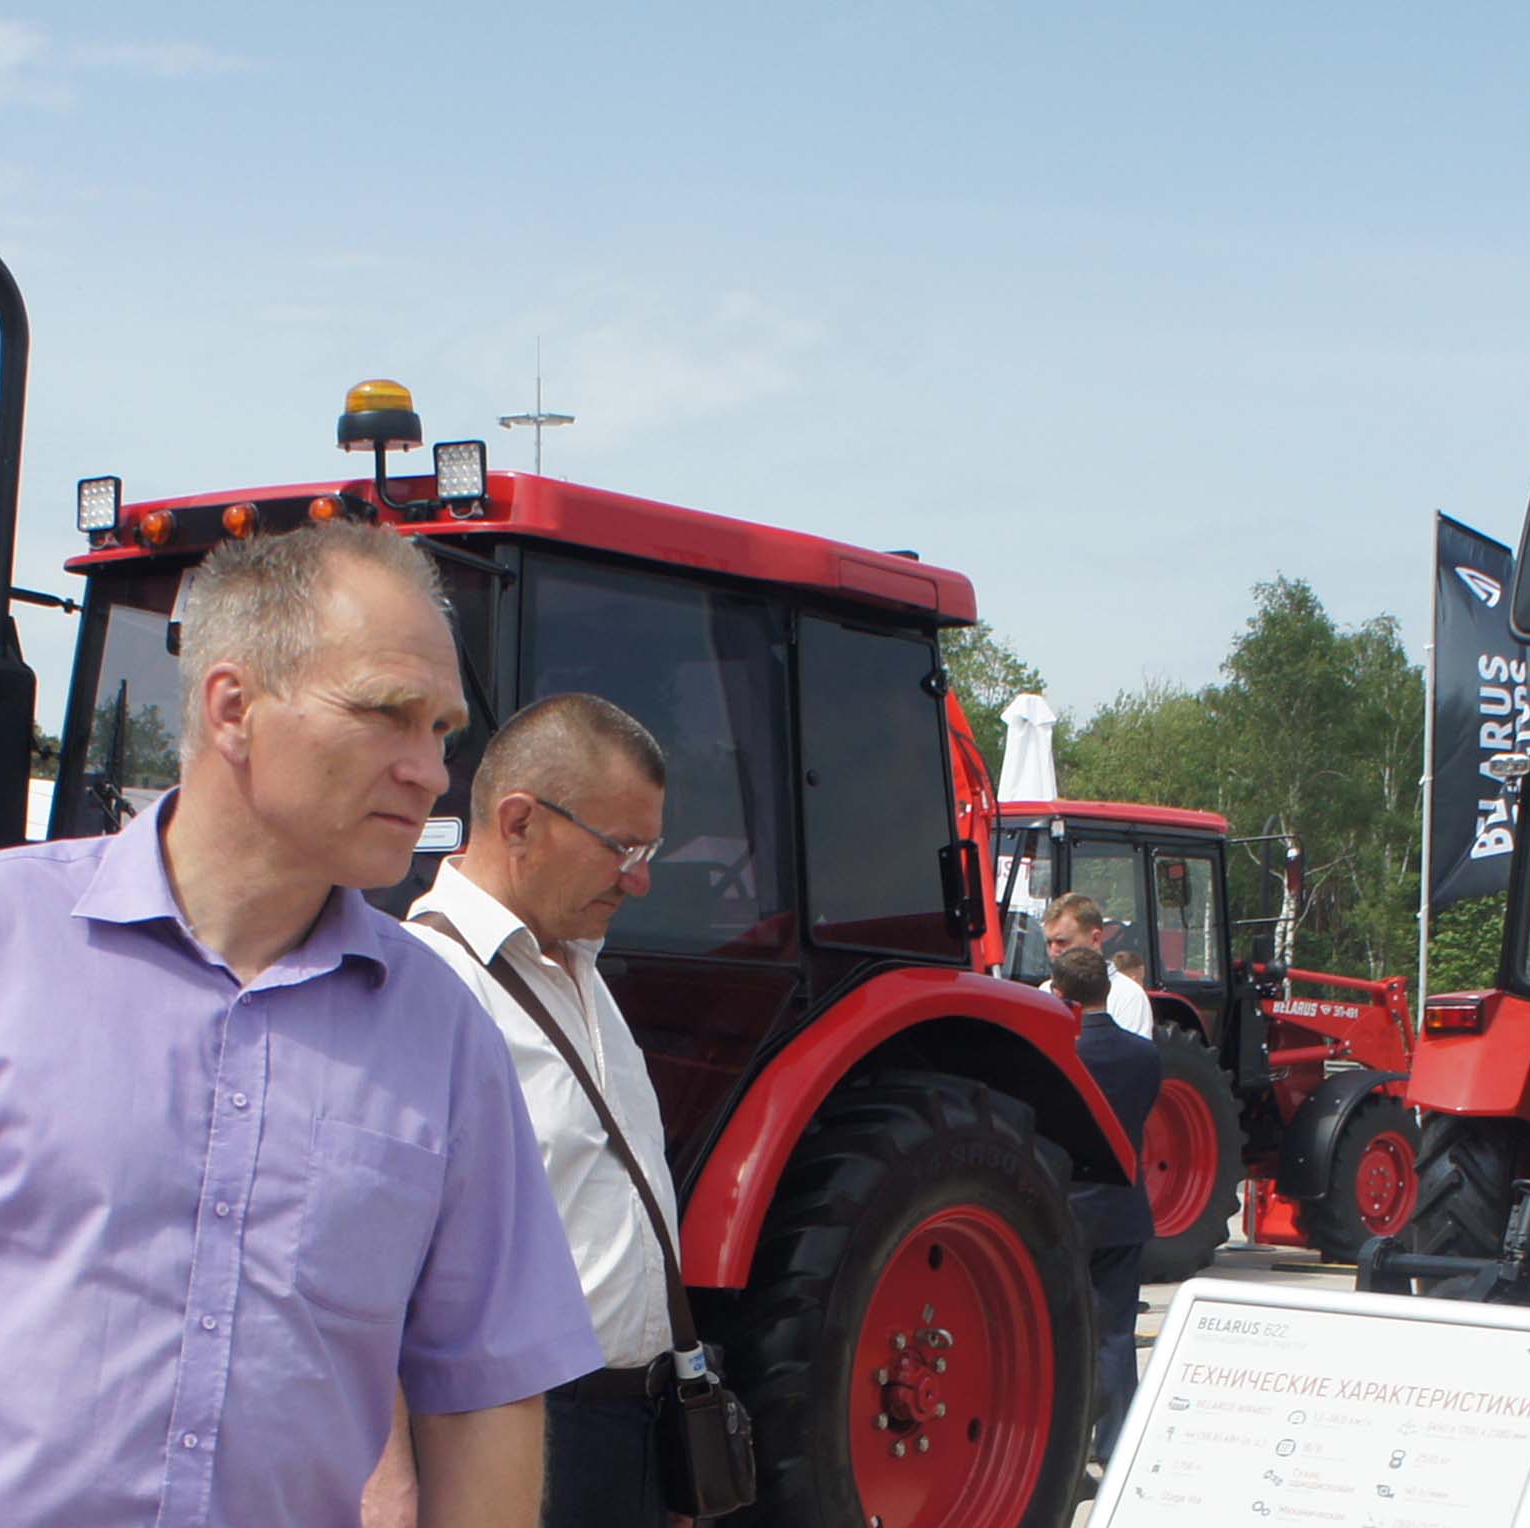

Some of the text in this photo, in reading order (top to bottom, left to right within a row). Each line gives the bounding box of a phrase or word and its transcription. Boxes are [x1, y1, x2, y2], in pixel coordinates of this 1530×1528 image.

[1272, 1001, 1319, 1017] BELARUS
[1197, 1317, 1260, 1335] BELARUS
[1180, 1362, 1333, 1398] ТЕХНИЧЕСКИЕ
